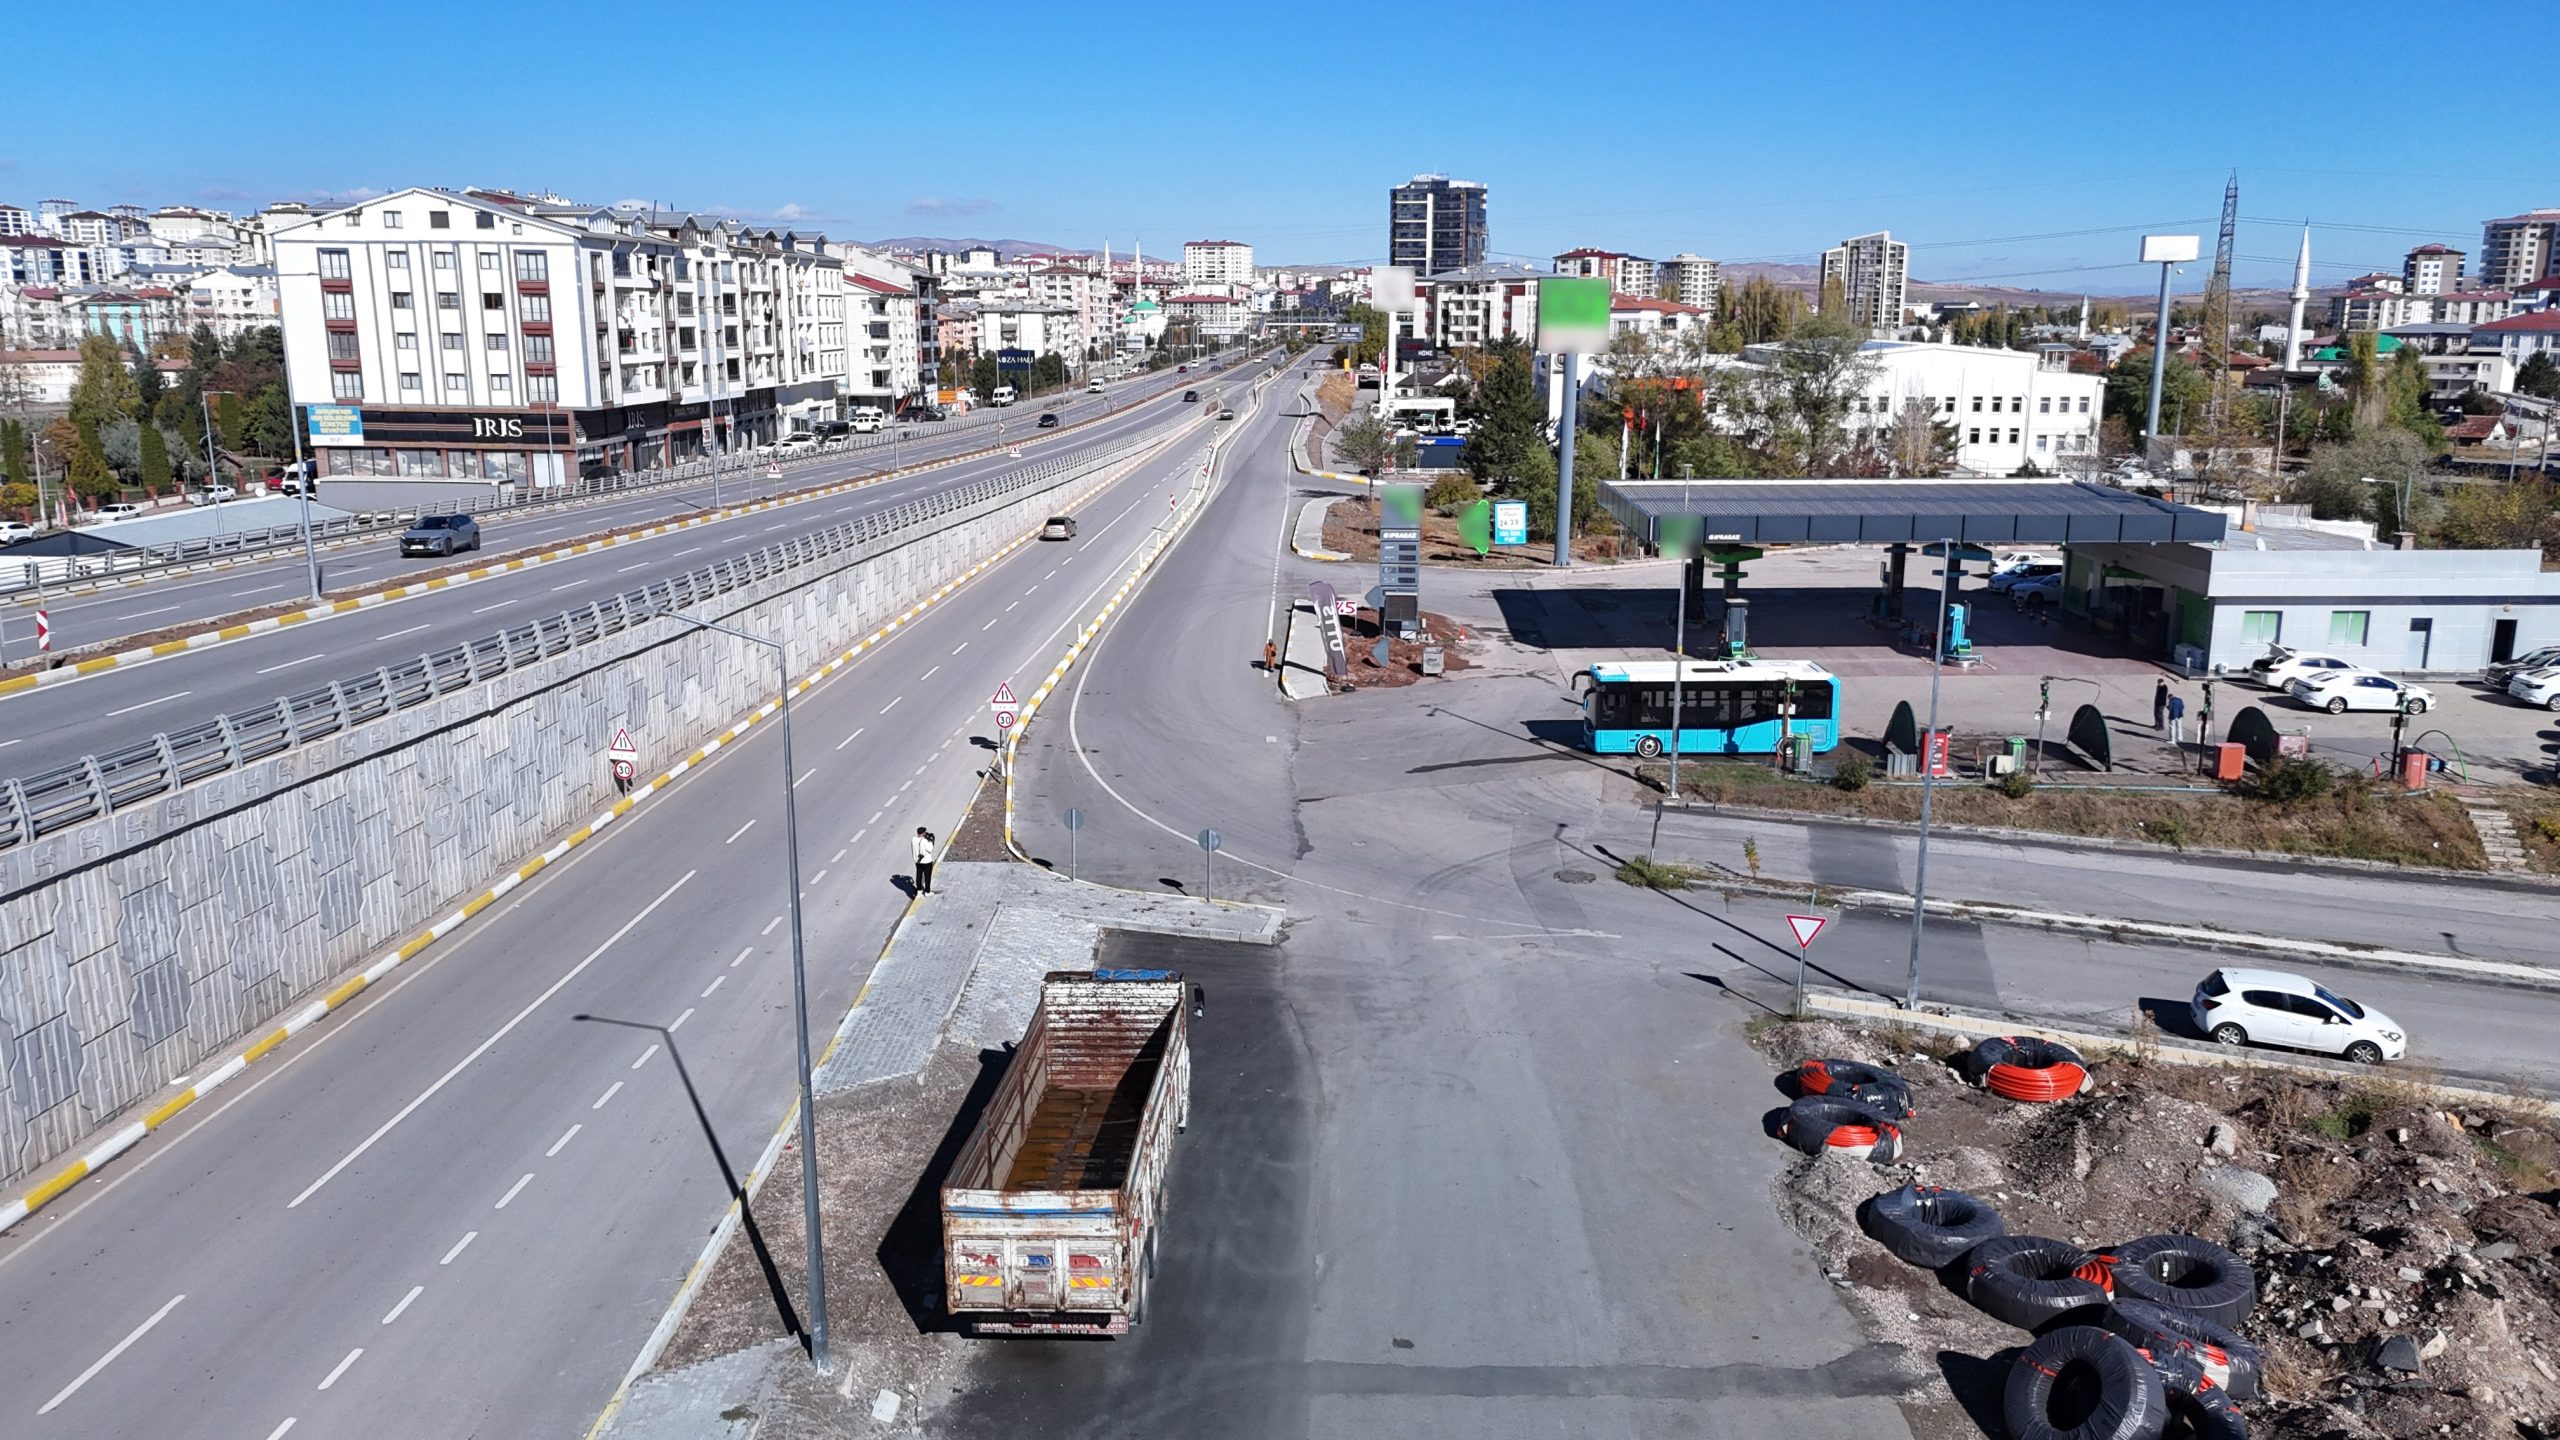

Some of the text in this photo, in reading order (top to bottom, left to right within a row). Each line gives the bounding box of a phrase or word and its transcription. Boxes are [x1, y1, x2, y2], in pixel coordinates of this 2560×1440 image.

[473, 418, 523, 437] IRIS
[1000, 716, 1010, 724] 30
[619, 765, 630, 774] 30
